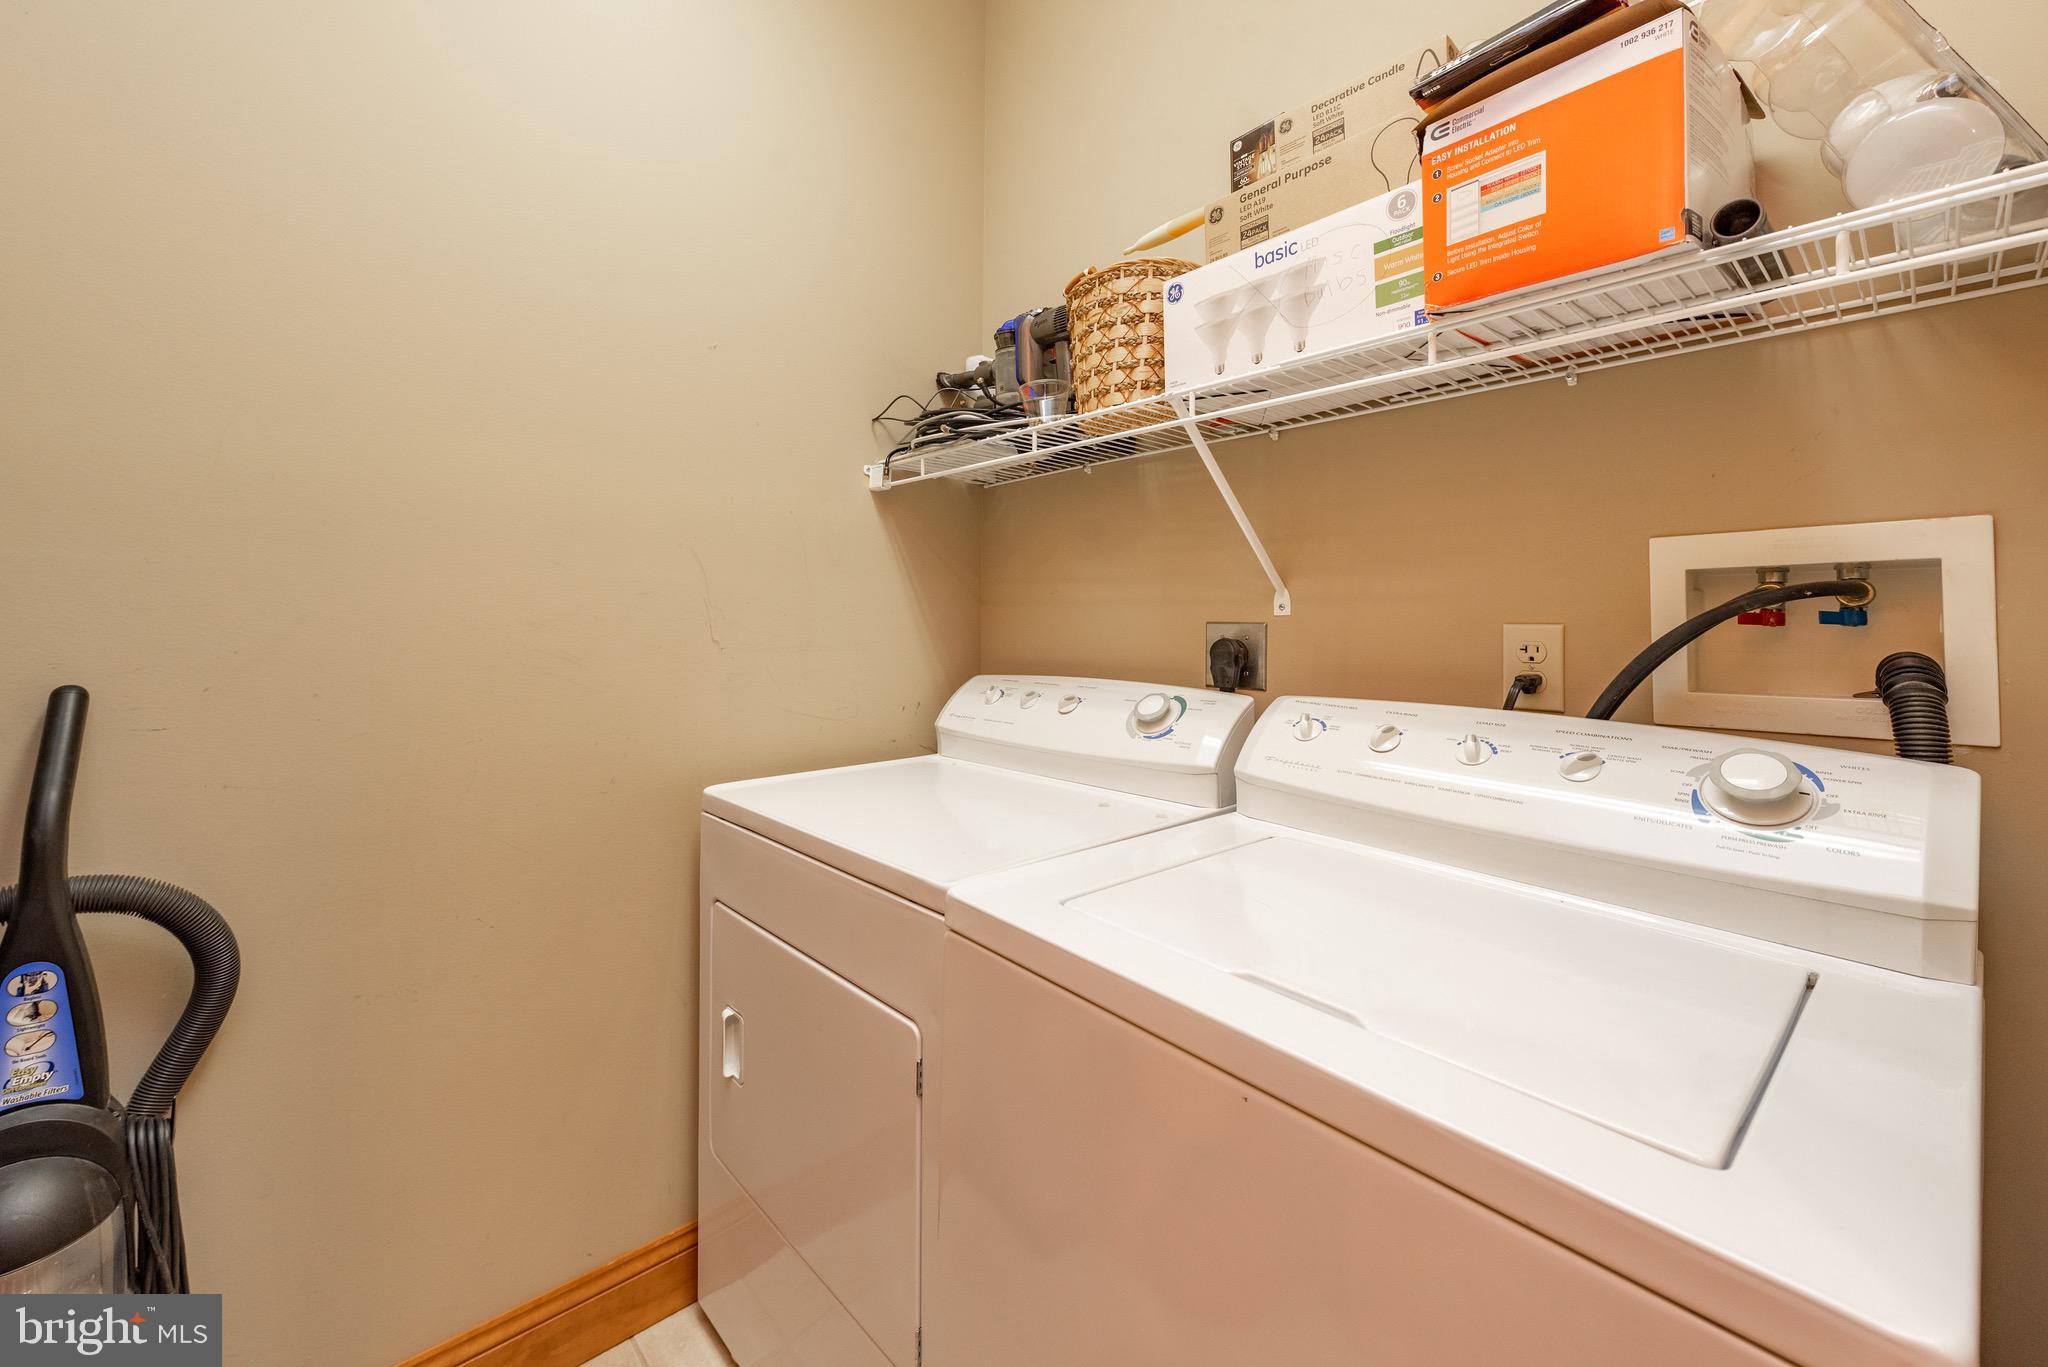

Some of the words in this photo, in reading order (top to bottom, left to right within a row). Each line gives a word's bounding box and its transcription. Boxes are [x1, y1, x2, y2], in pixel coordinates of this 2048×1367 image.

[1620, 35, 1639, 48] 1002
[1640, 27, 1656, 40] 936
[1658, 19, 1674, 32] 217
[1655, 29, 1674, 41] WHITE
[1311, 82, 1366, 113] Decorative
[1367, 63, 1406, 86] Candle
[1312, 111, 1325, 122] LED
[1326, 110, 1345, 124] White
[1451, 106, 1485, 126] Commercial
[1451, 119, 1473, 134] Electric
[1431, 149, 1453, 166] EASY
[1454, 122, 1517, 154] INSTALLATION
[1513, 143, 1526, 153] LED
[1239, 176, 1281, 203] General
[1284, 155, 1332, 183] Purpose
[1239, 202, 1252, 214] LED
[1253, 196, 1266, 209] A19
[1397, 194, 1407, 209] 6
[1239, 212, 1253, 222] Soft
[1253, 203, 1274, 216] White
[1393, 207, 1411, 217] PACK
[1389, 222, 1416, 236] Floodlight
[1517, 223, 1534, 234] Color
[1518, 229, 1540, 241] Switch
[1254, 240, 1298, 269] basic
[1300, 236, 1319, 252] LED
[1466, 260, 1479, 271] LED
[1511, 244, 1537, 257] Housing
[1383, 256, 1405, 271] Warm
[1826, 847, 1861, 858] COLORS
[11, 1070, 55, 1087] Empty
[1, 1091, 41, 1106] Washable
[43, 1084, 69, 1097] Filters
